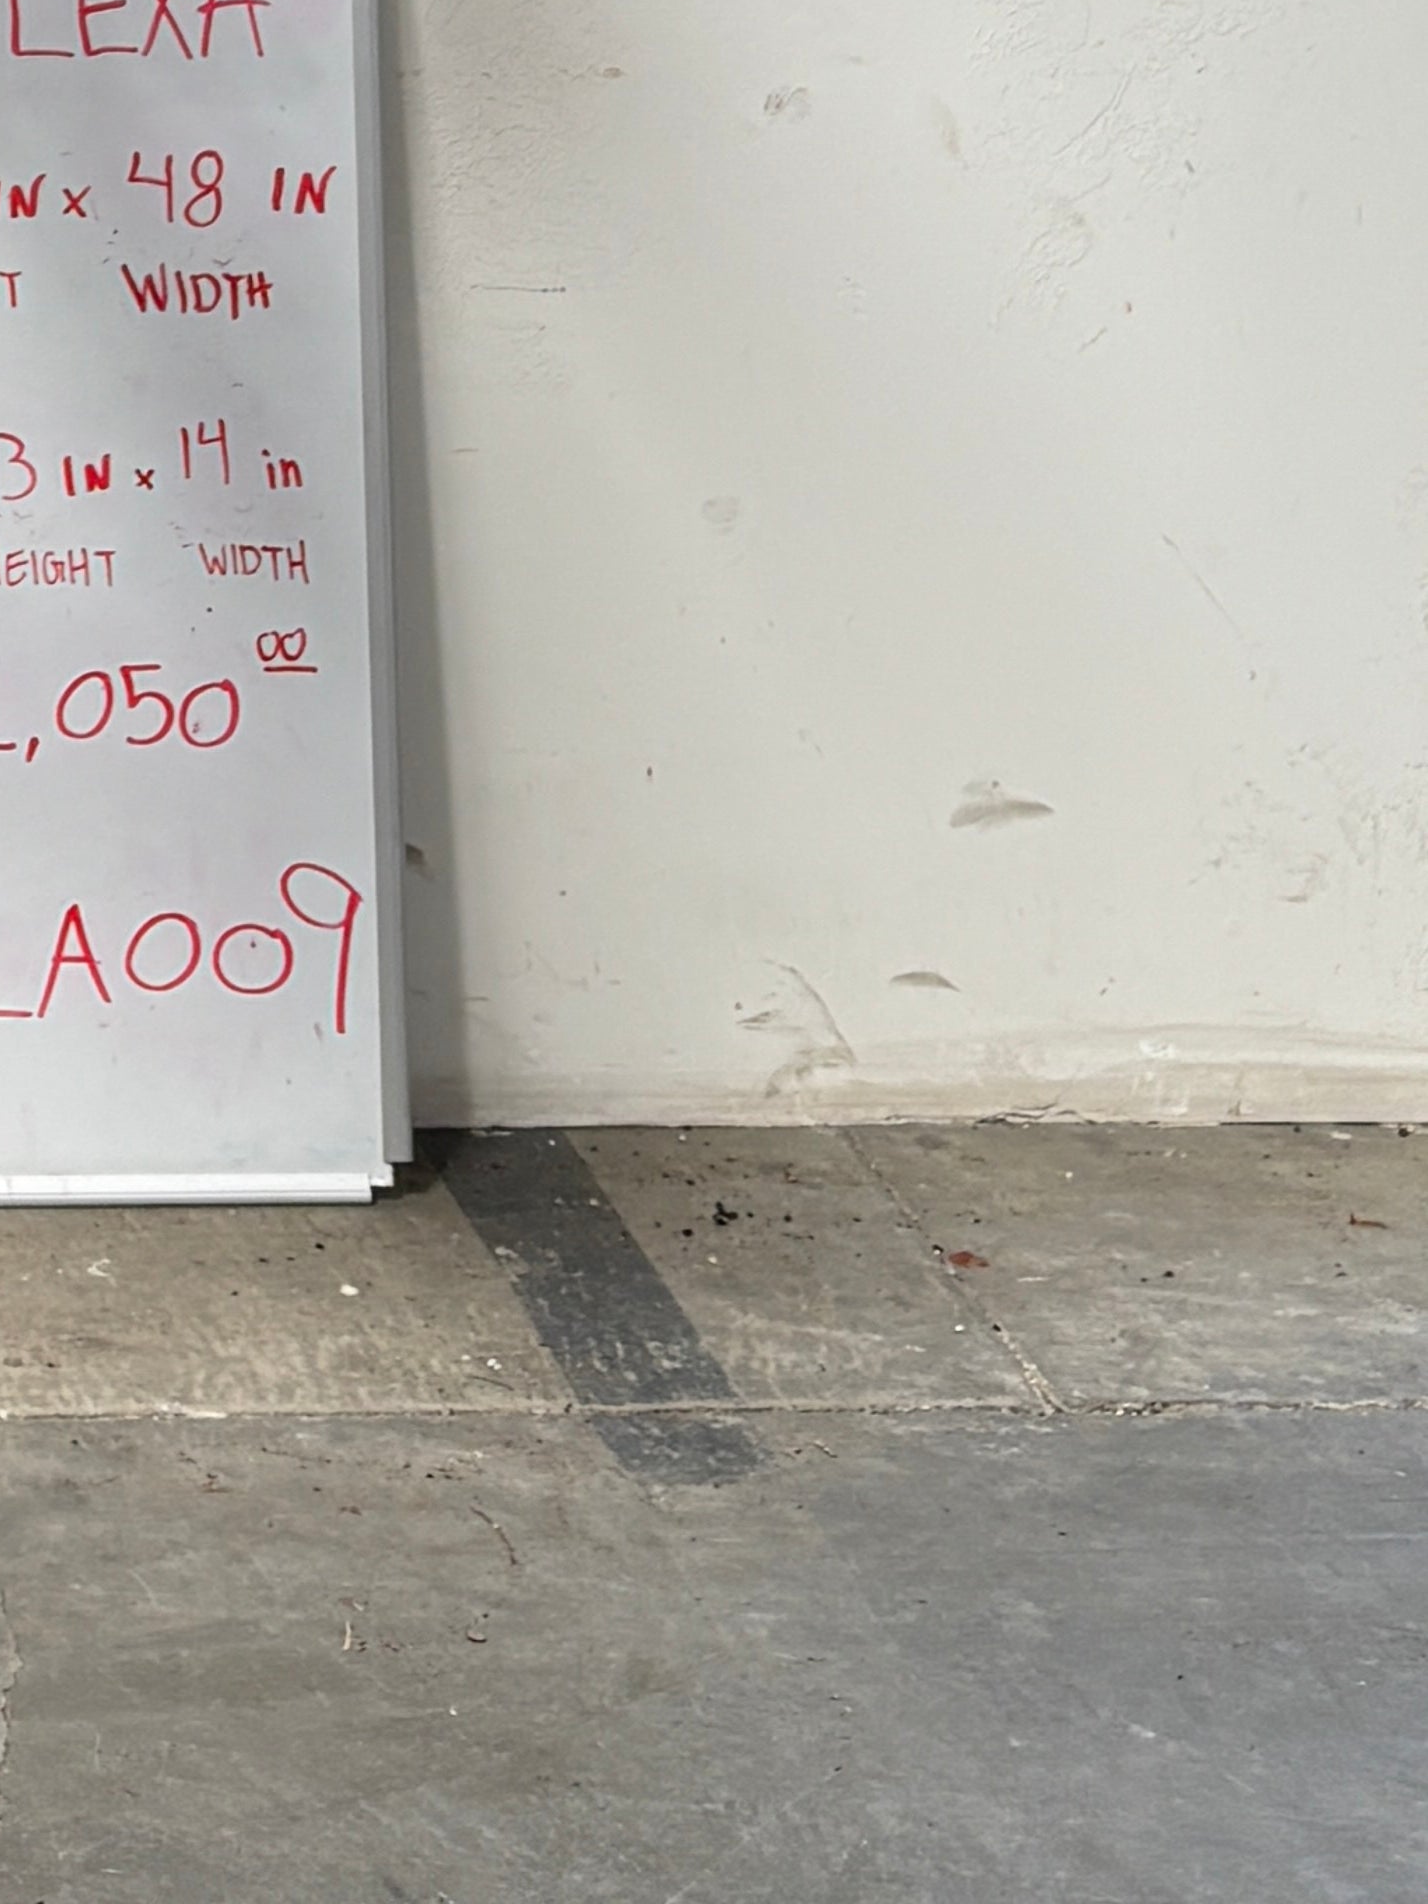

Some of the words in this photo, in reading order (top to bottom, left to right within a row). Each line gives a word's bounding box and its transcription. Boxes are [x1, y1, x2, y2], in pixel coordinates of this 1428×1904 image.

[127, 150, 225, 229] 48
[121, 265, 274, 320] WIDTH
[179, 418, 230, 486] 14
[261, 450, 304, 491] in
[198, 540, 310, 584] WIDTH
